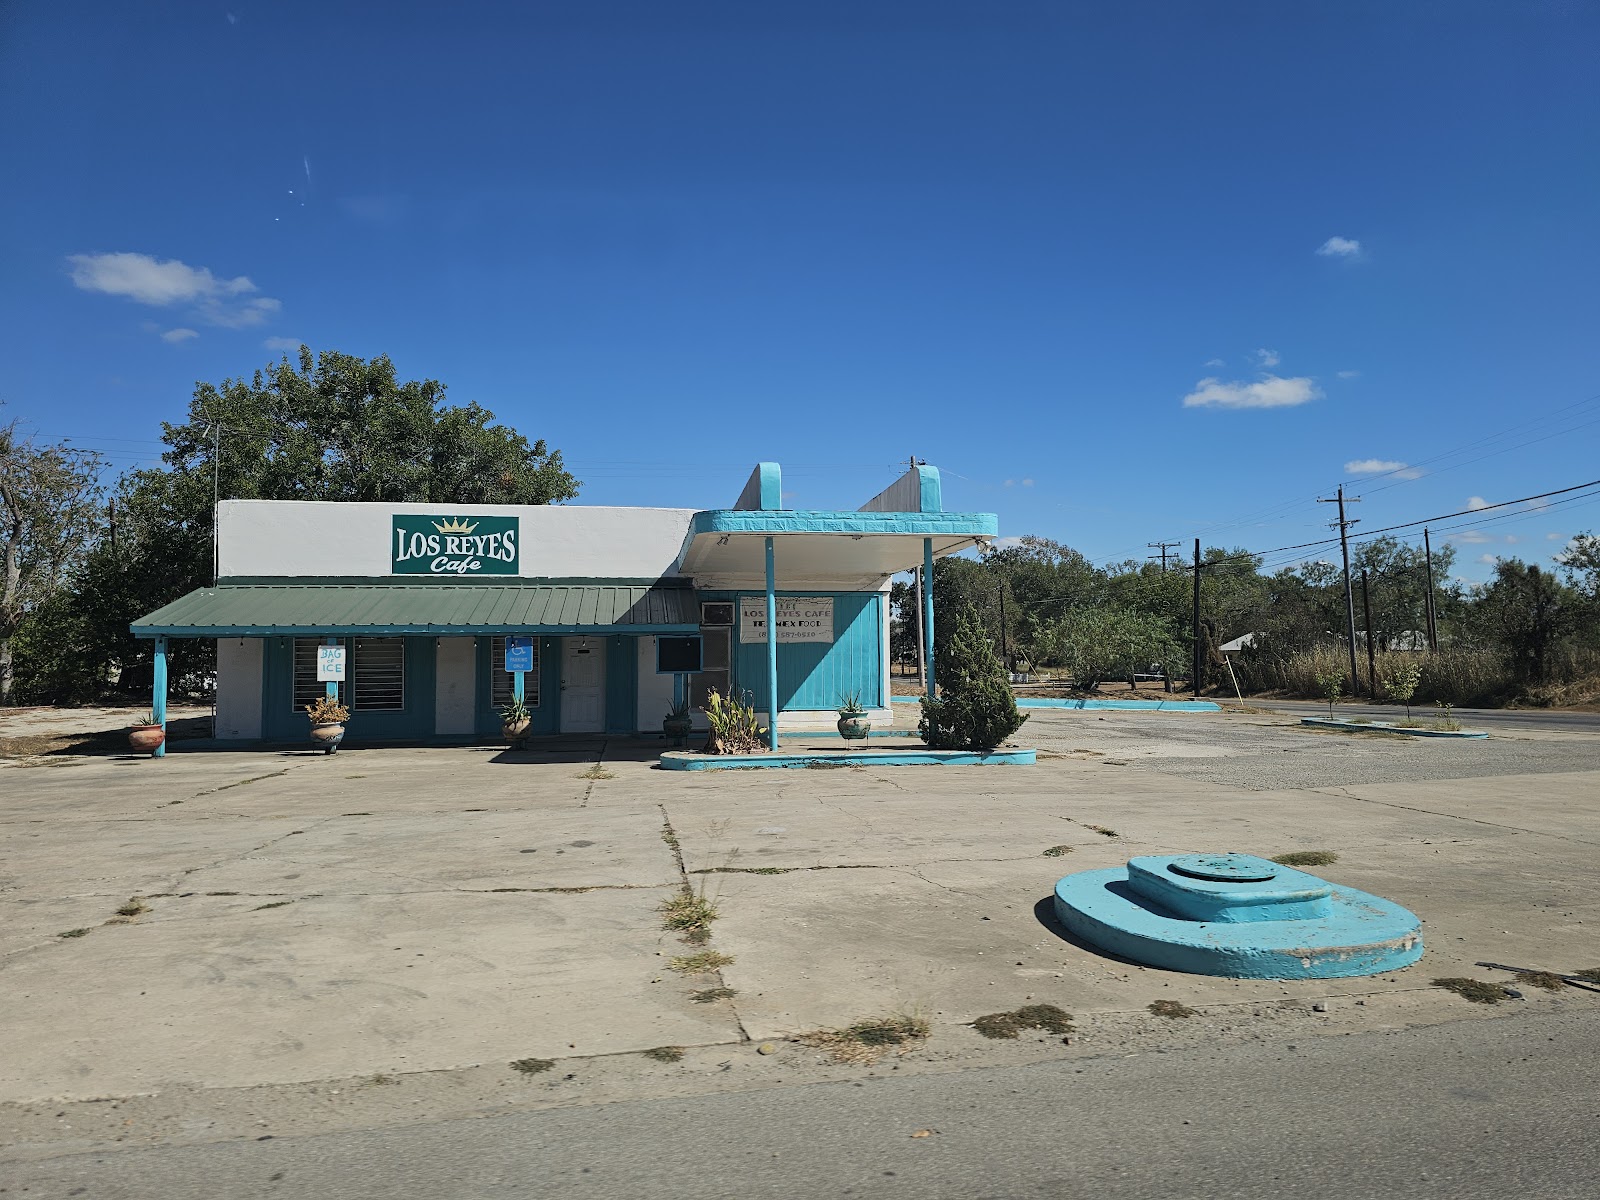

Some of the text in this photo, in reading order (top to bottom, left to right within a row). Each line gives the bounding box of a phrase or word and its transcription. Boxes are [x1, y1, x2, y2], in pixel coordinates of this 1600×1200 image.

[396, 528, 516, 562] LOS REYES
[430, 556, 482, 574] Cafe
[744, 610, 831, 618] LOS EYES CAFE
[320, 648, 342, 658] BAG
[322, 663, 342, 673] ICE
